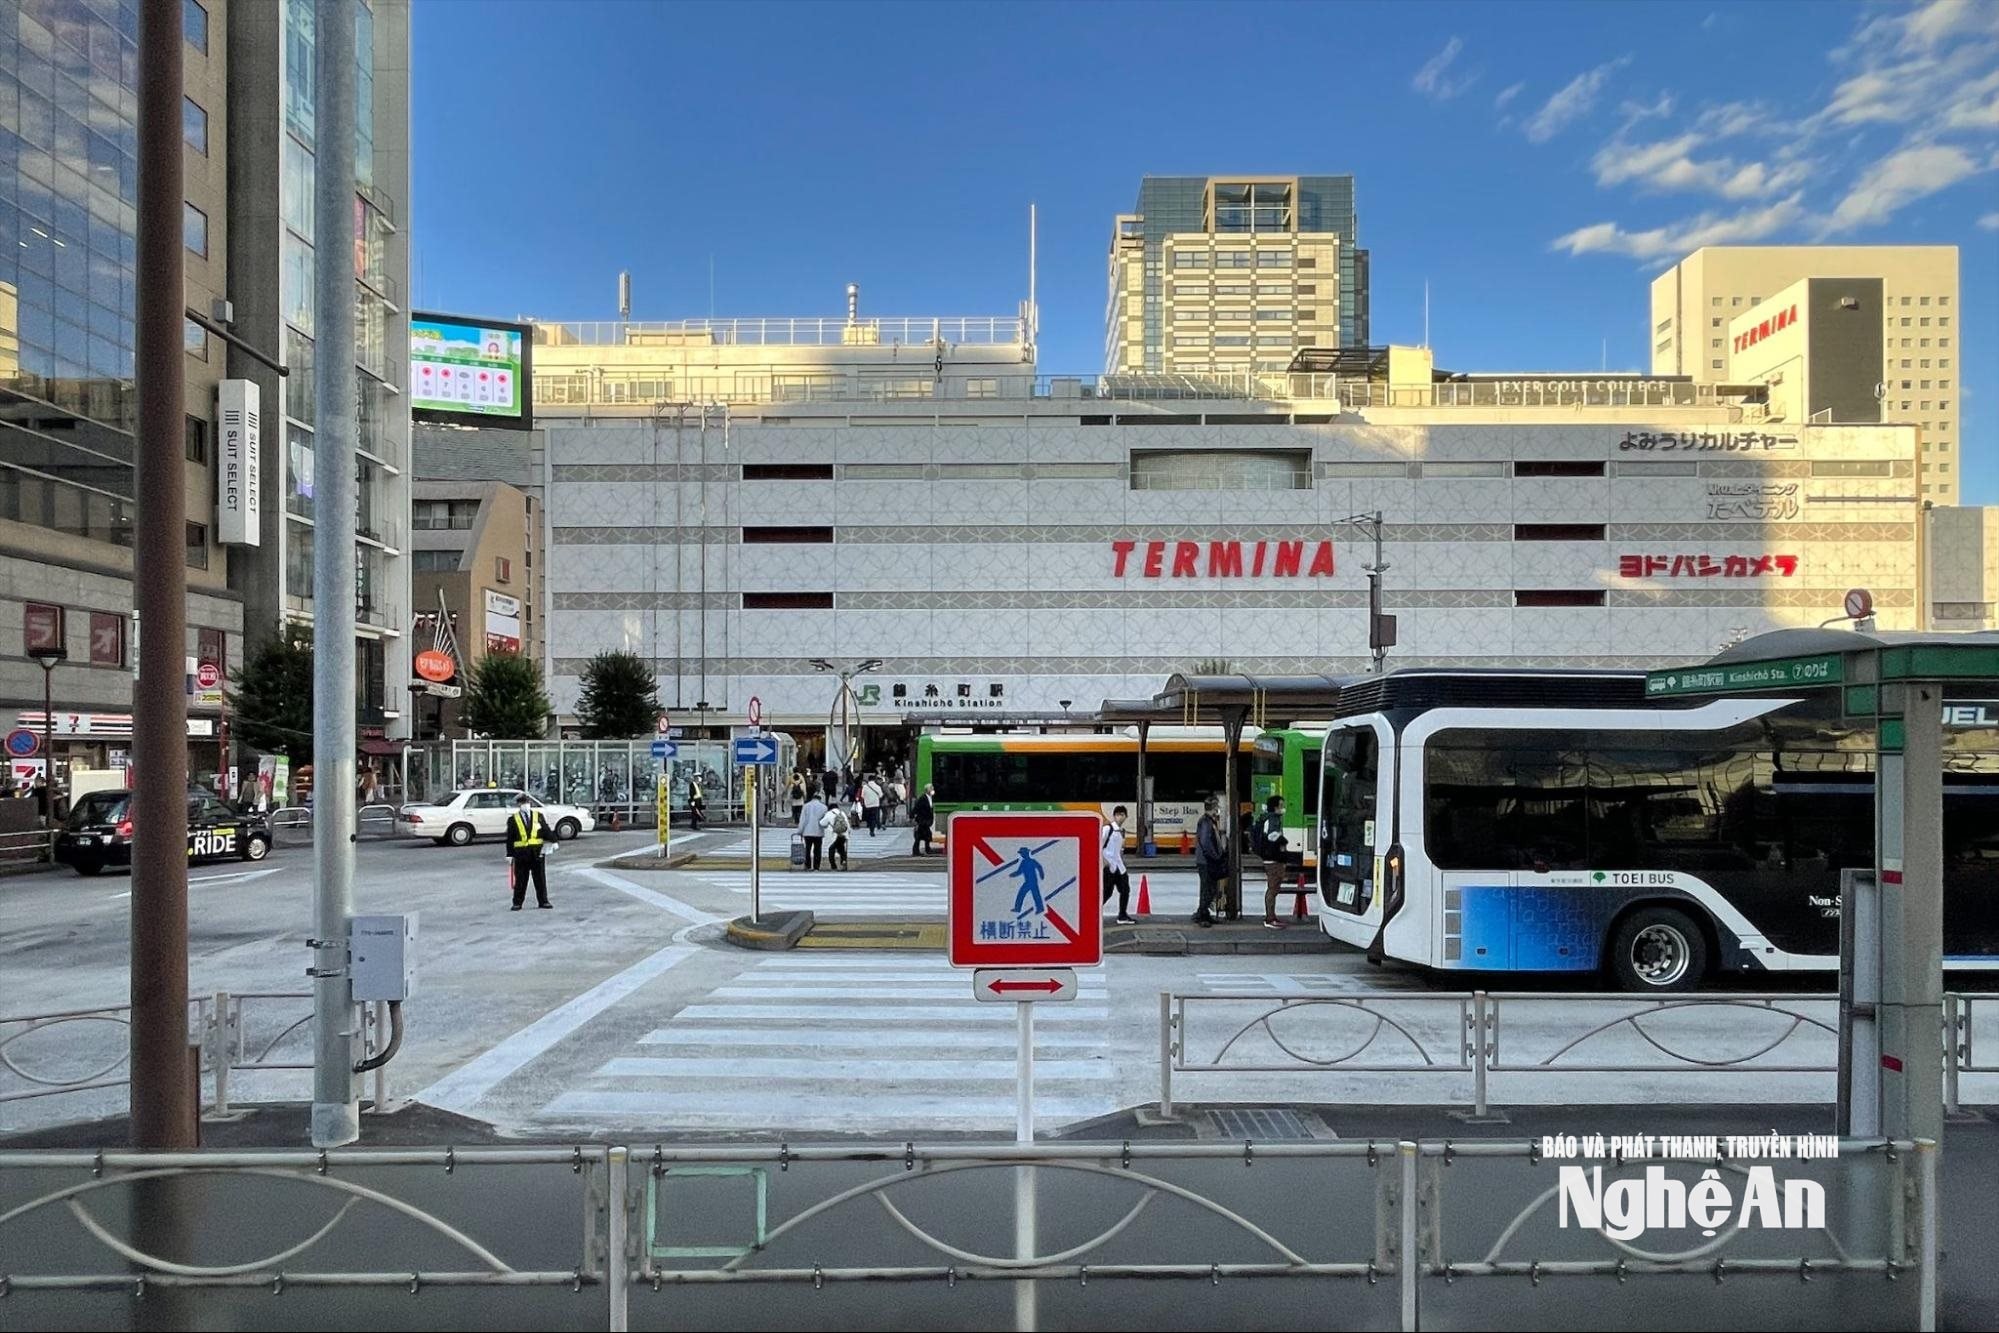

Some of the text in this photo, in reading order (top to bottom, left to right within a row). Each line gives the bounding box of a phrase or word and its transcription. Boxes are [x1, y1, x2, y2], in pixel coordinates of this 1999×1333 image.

[1733, 304, 1798, 355] TERMINA
[1547, 380, 1589, 393] GOLF
[1596, 380, 1667, 393] COLLEGE
[1619, 431, 1799, 452] よみうりカルチャー
[227, 430, 237, 512] SUIT SELECT
[248, 433, 257, 514] SUIT SELECT
[1112, 541, 1335, 578] TERMINA
[1619, 554, 1799, 578] ヨドバシカメラ
[855, 684, 881, 703] JR
[959, 698, 1003, 708] Station
[1612, 873, 1675, 884] TOEI BUS
[980, 920, 1051, 940] 横断禁止
